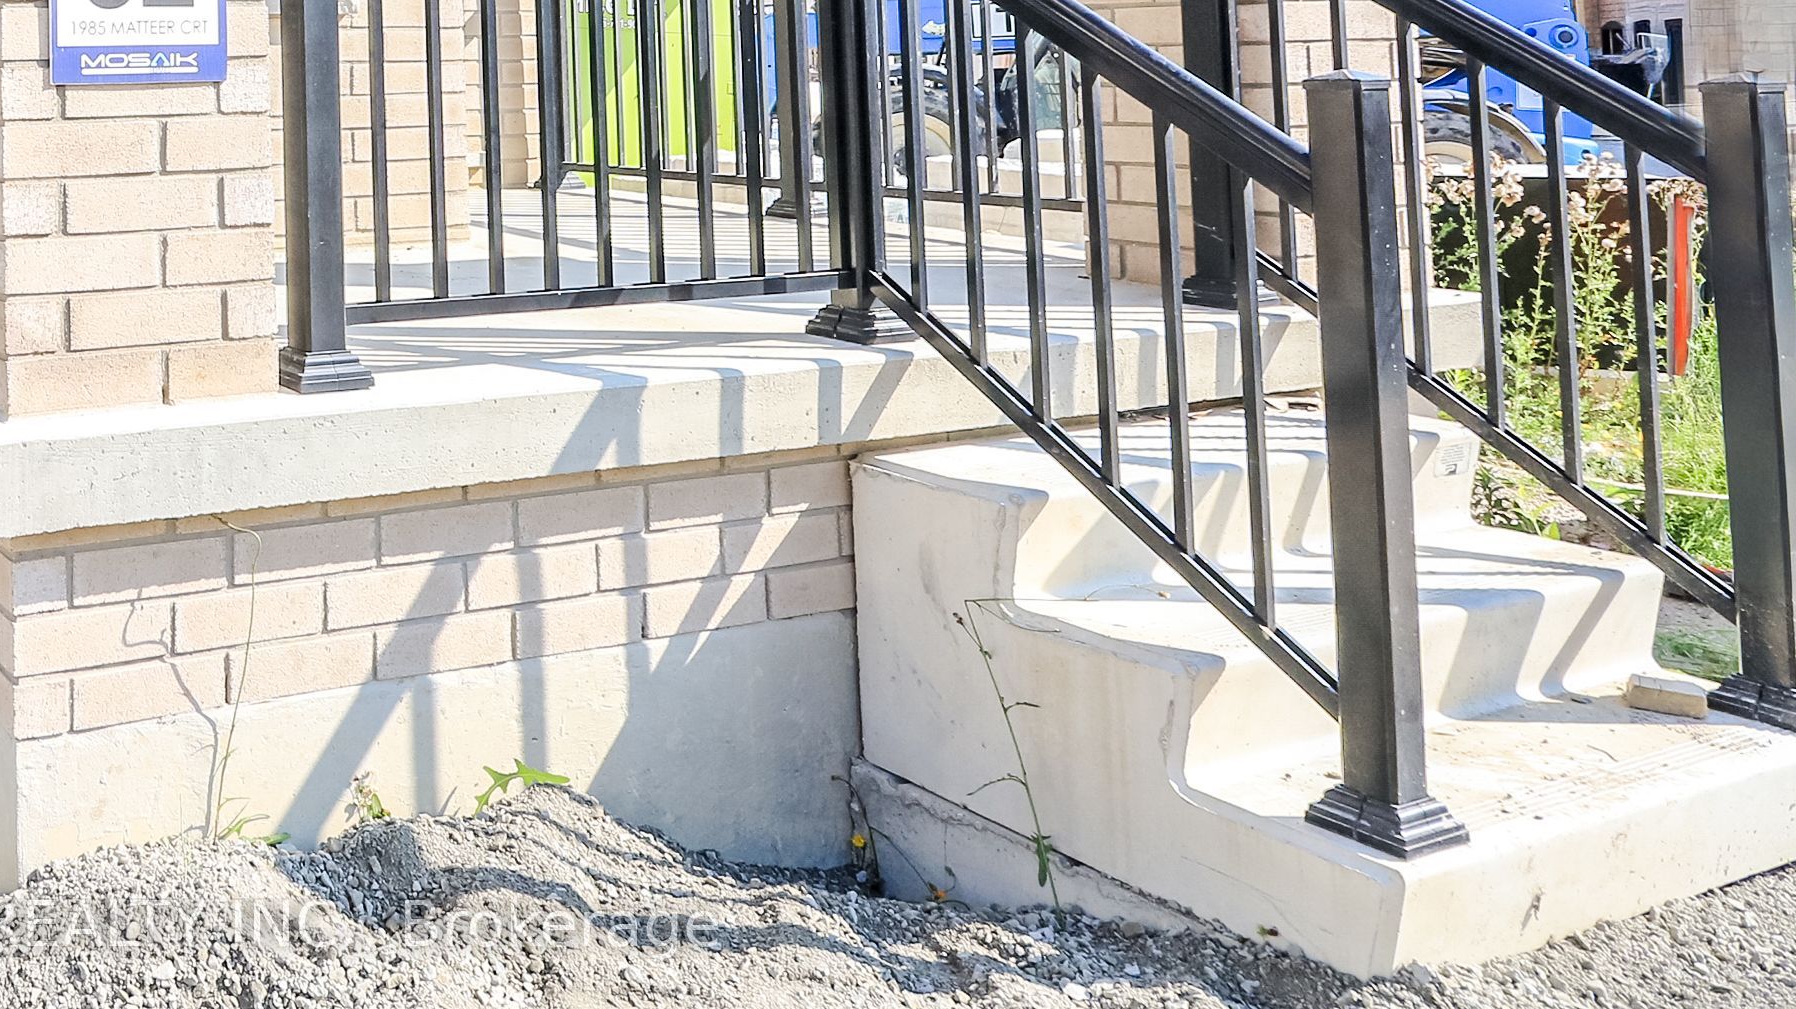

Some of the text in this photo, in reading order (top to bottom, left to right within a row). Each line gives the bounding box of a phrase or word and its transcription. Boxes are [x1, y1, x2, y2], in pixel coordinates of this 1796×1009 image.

[71, 19, 208, 36] 1985 MATTEER CRT
[80, 52, 199, 68] MOSAIK
